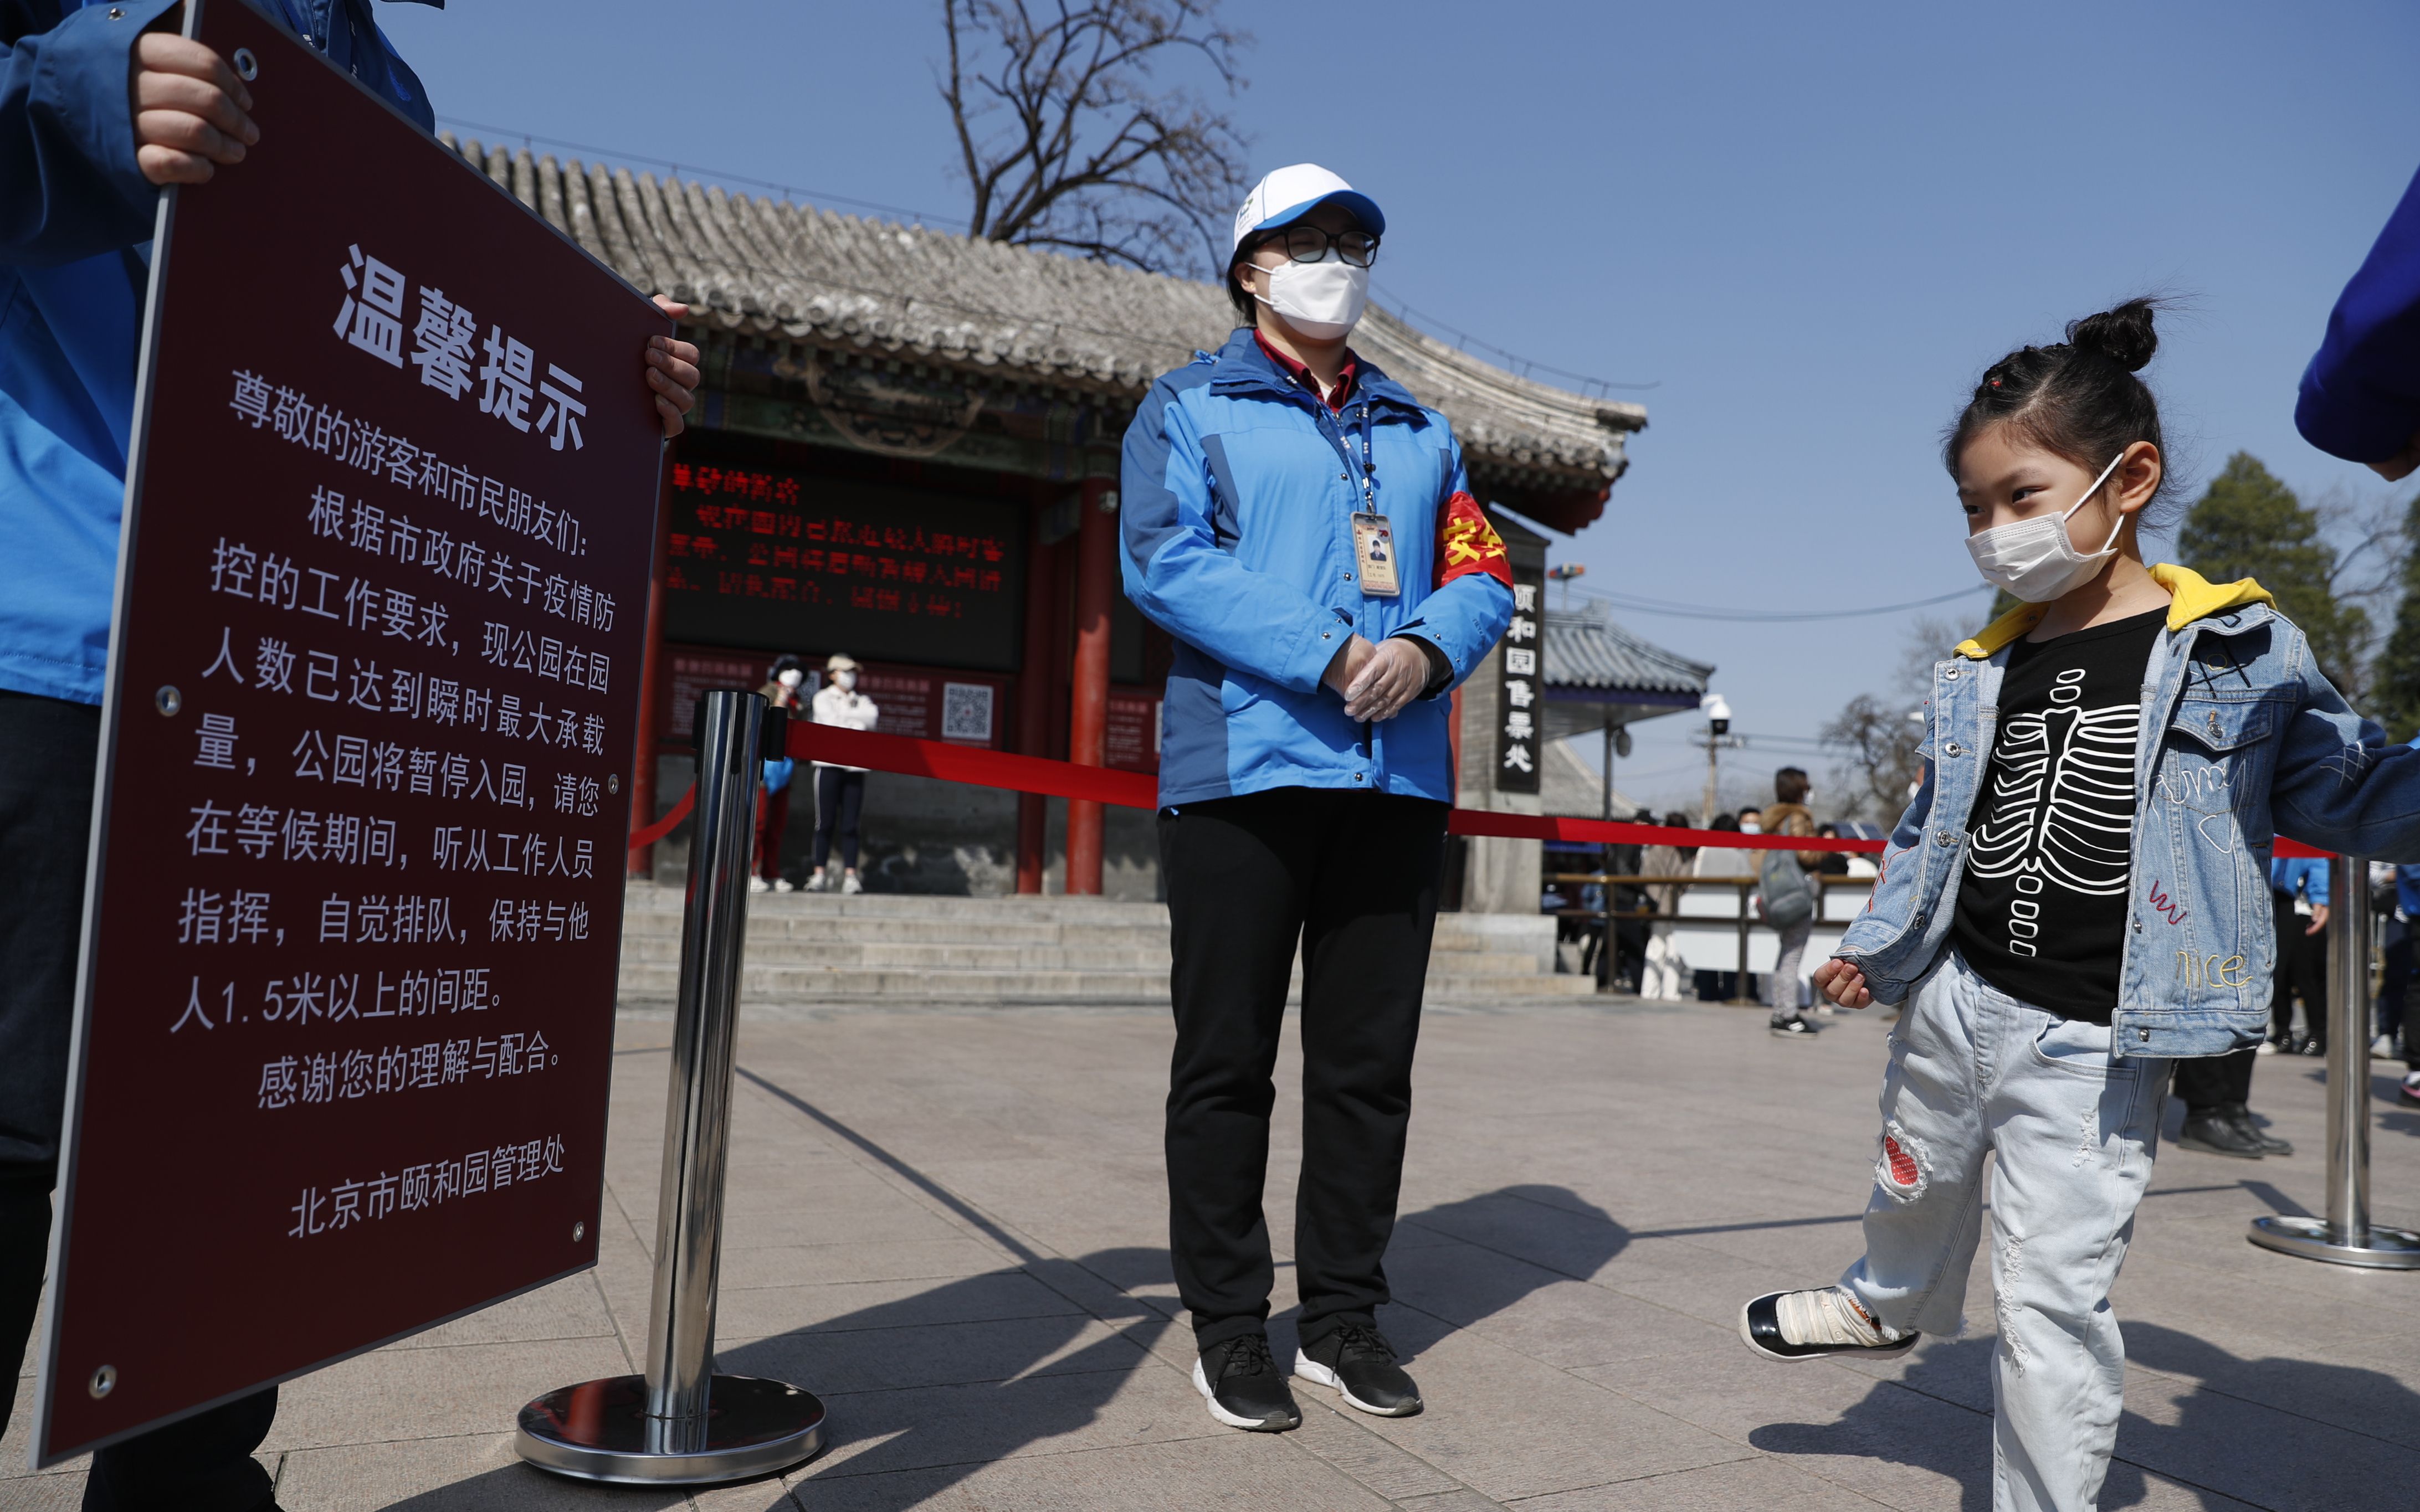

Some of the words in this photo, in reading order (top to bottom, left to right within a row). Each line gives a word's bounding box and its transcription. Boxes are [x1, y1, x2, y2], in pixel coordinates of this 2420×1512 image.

[333, 244, 587, 451] 温馨提示
[211, 537, 610, 695] 控的工作要求，现公园在园
[308, 485, 616, 632] 根据市政府关于疫情防
[201, 626, 606, 756] 人数已达到瞬时最大承载
[186, 799, 593, 880] 在等候期间，听从工作人员
[258, 1030, 558, 1109] 感谢您的理解与配合。
[288, 1134, 565, 1239] 北京市颐和园管理处
